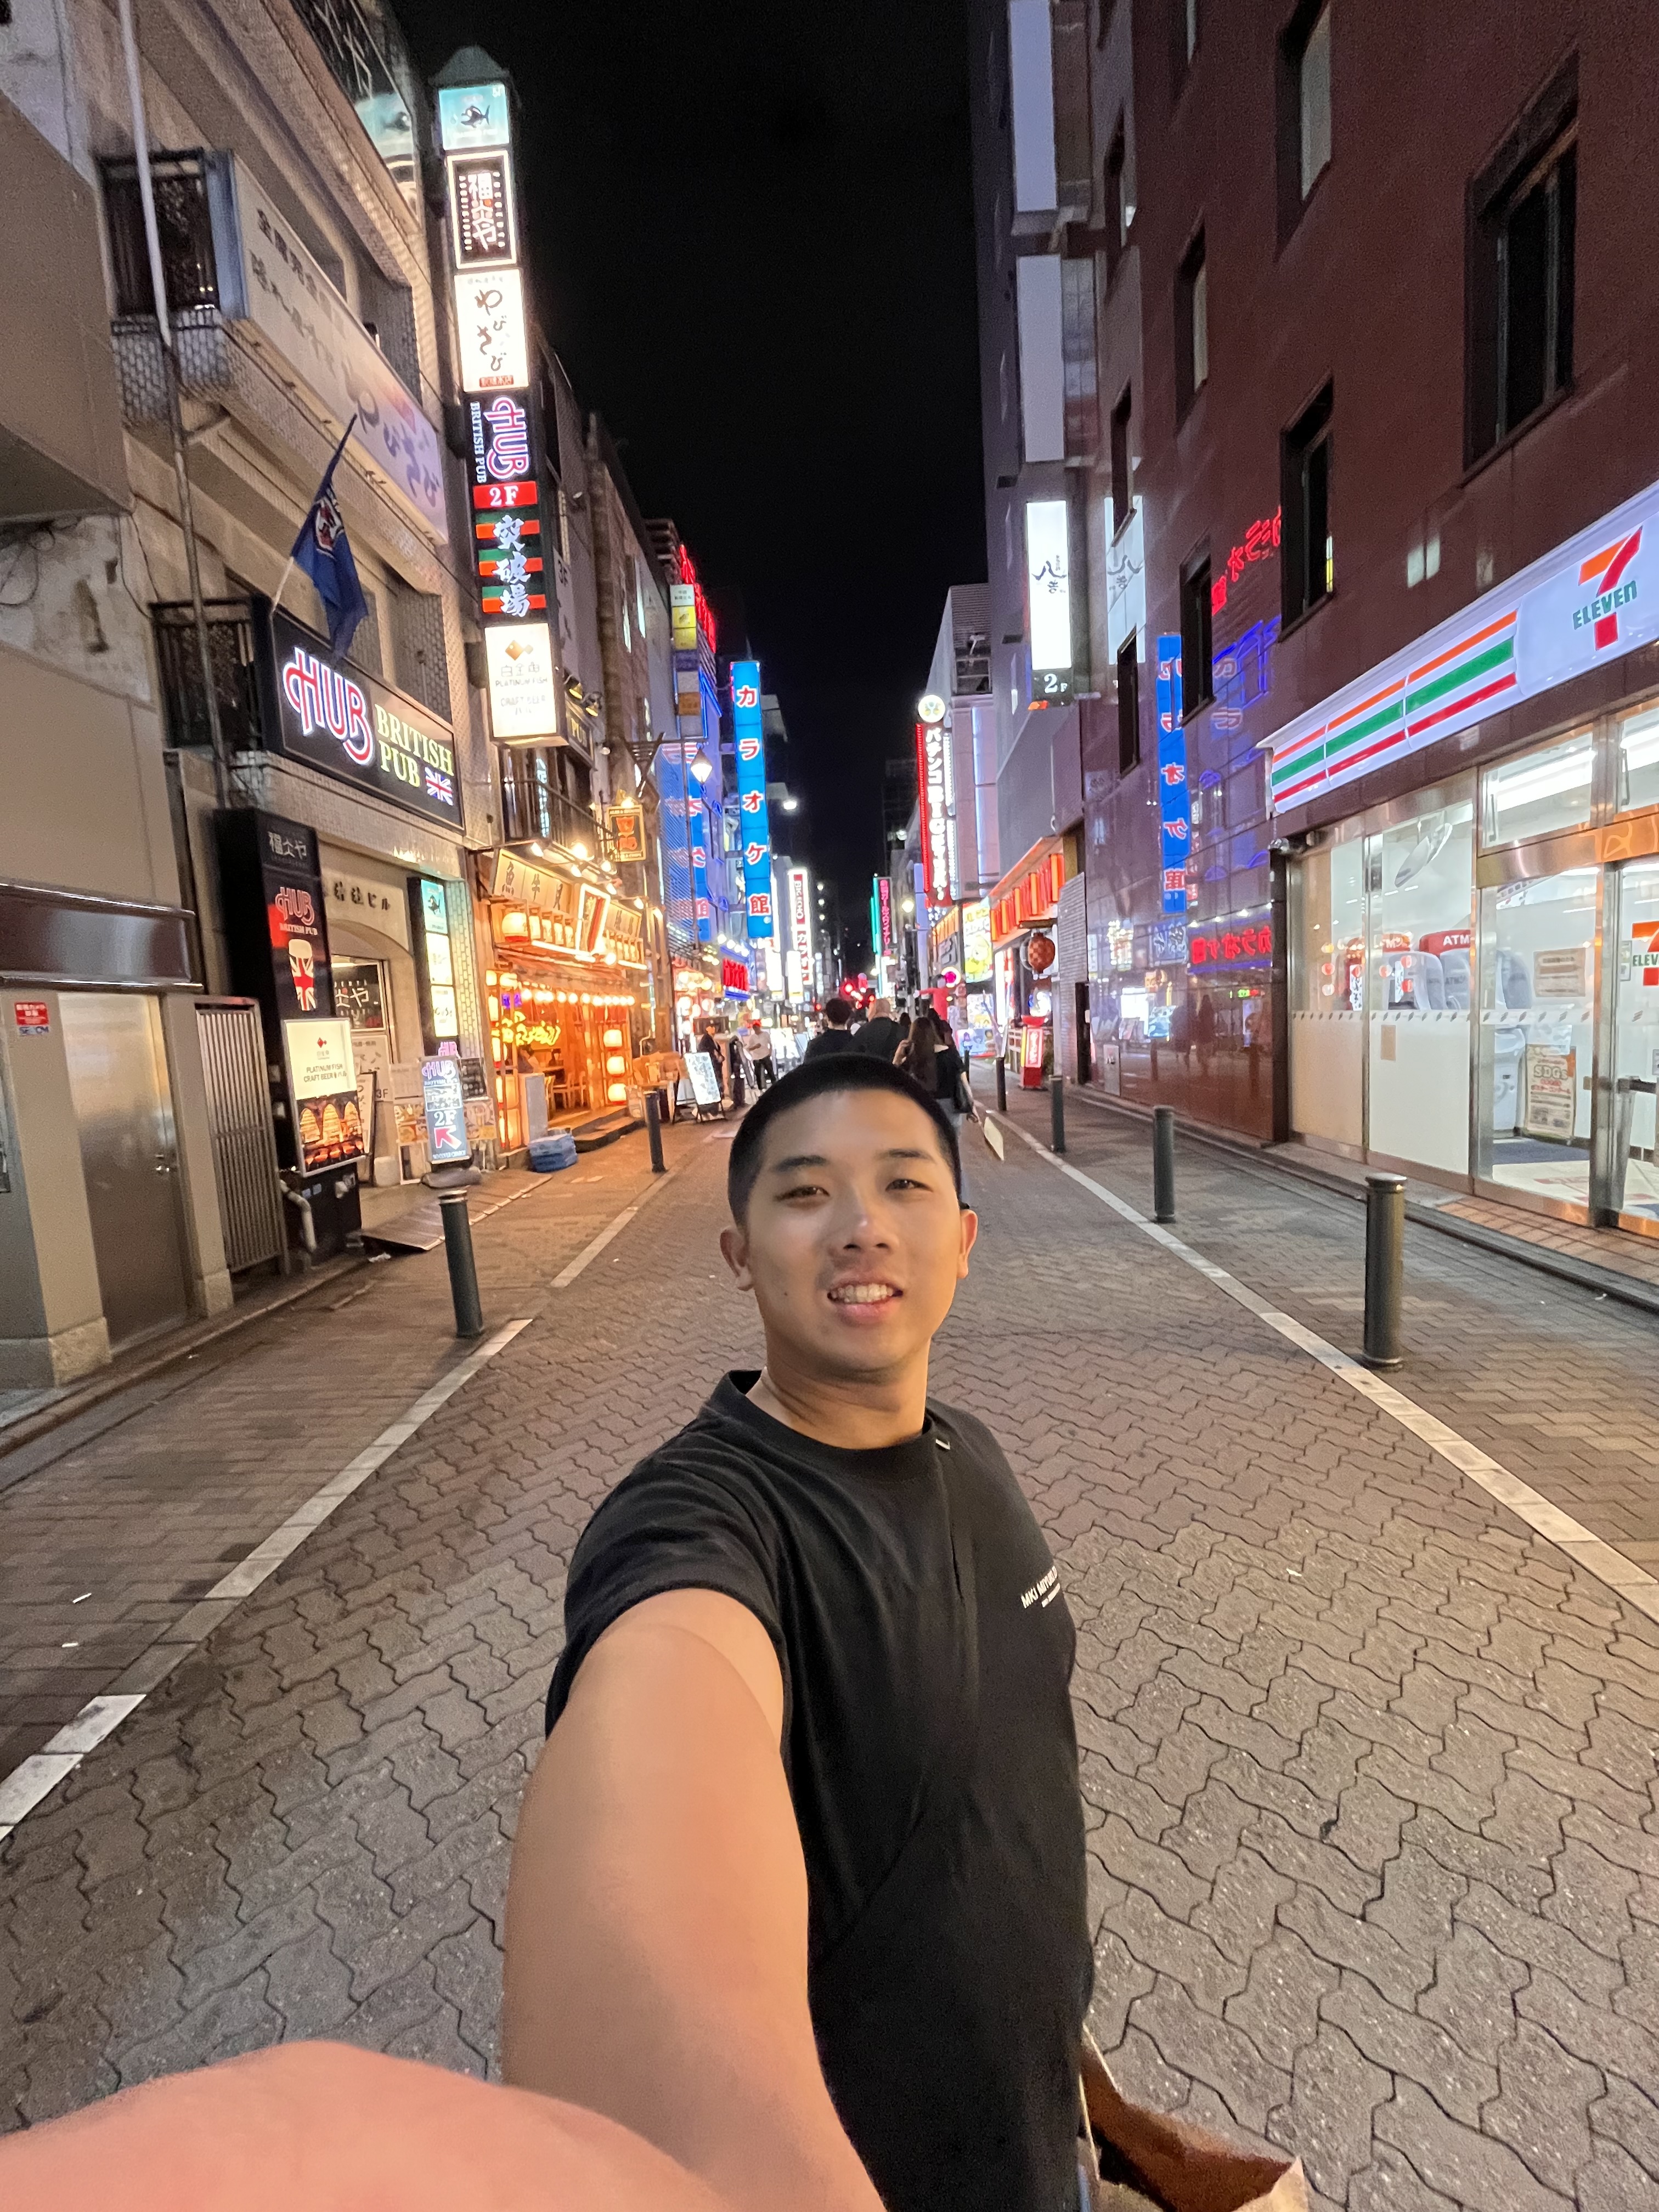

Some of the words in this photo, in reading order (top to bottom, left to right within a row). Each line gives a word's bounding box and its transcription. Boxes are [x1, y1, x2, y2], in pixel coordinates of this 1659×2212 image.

[470, 402, 485, 453] BRITISH
[484, 397, 531, 481] HUB
[476, 454, 487, 483] PUB
[489, 484, 519, 507] 2F
[1578, 525, 1643, 651] 7
[1044, 674, 1068, 693] 2F
[282, 646, 375, 765] HUB
[375, 704, 454, 777] BRITISH
[379, 740, 421, 787] PUB
[737, 685, 771, 917] カラオケ館
[501, 861, 515, 896] 魚
[275, 886, 315, 926] HUB
[280, 923, 304, 934] BRITISH
[306, 927, 318, 935] PUB
[1443, 934, 1470, 946] ATM
[421, 1060, 456, 1080] HUB
[1533, 1064, 1568, 1080] SDGs
[376, 1088, 388, 1098] 3F
[433, 1109, 457, 1126] 2F
